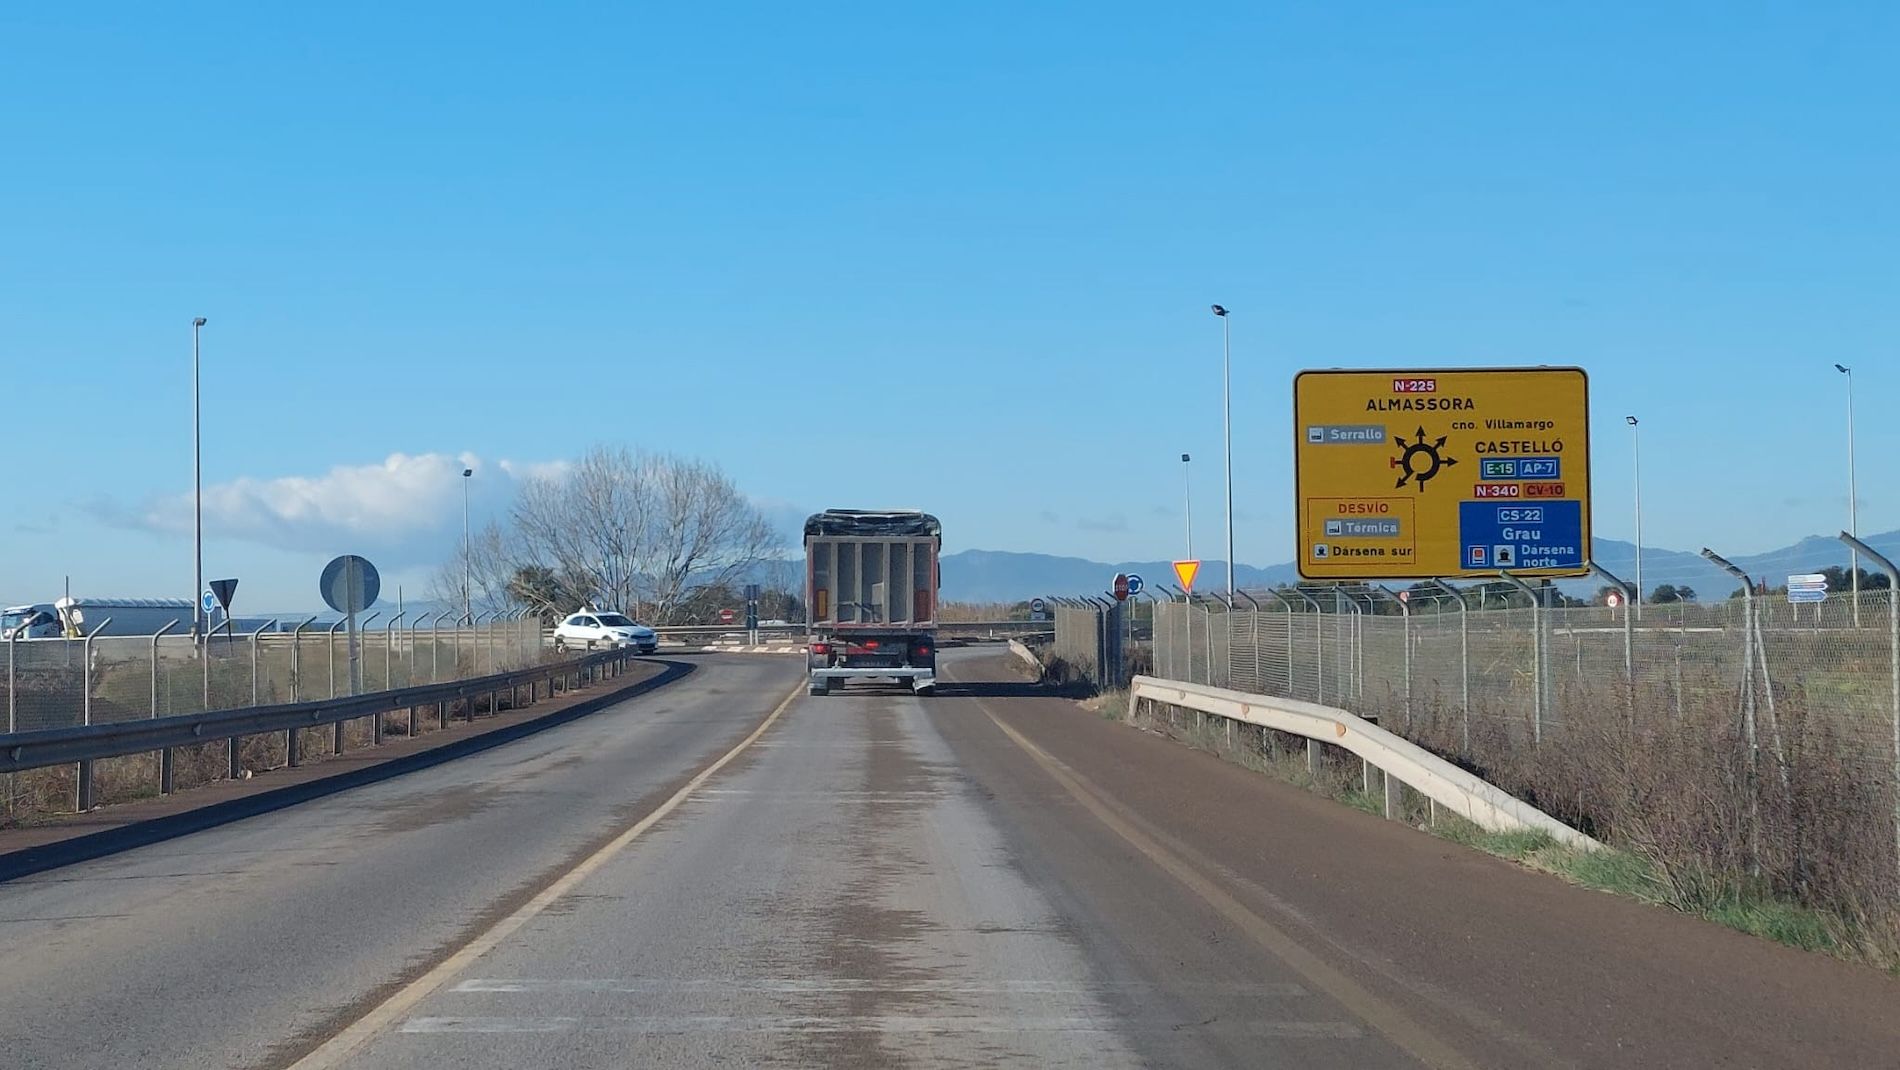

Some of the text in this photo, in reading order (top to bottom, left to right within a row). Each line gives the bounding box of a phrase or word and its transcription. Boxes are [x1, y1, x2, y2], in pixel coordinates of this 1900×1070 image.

[1394, 381, 1434, 391] N-225
[1366, 399, 1474, 411] ALMASSORA
[1485, 420, 1554, 430] Villamargo
[1330, 429, 1382, 440] Serrallo
[1475, 438, 1563, 453] CASTELLÓ
[1486, 463, 1553, 474] E-15 AP-7
[1476, 485, 1563, 496] N-340 CV-10
[1500, 510, 1541, 521] CS-22
[1502, 527, 1541, 540] Grau
[1333, 545, 1412, 556] Dársena sur
[1521, 544, 1574, 555] Dársena
[1523, 558, 1558, 567] norte
